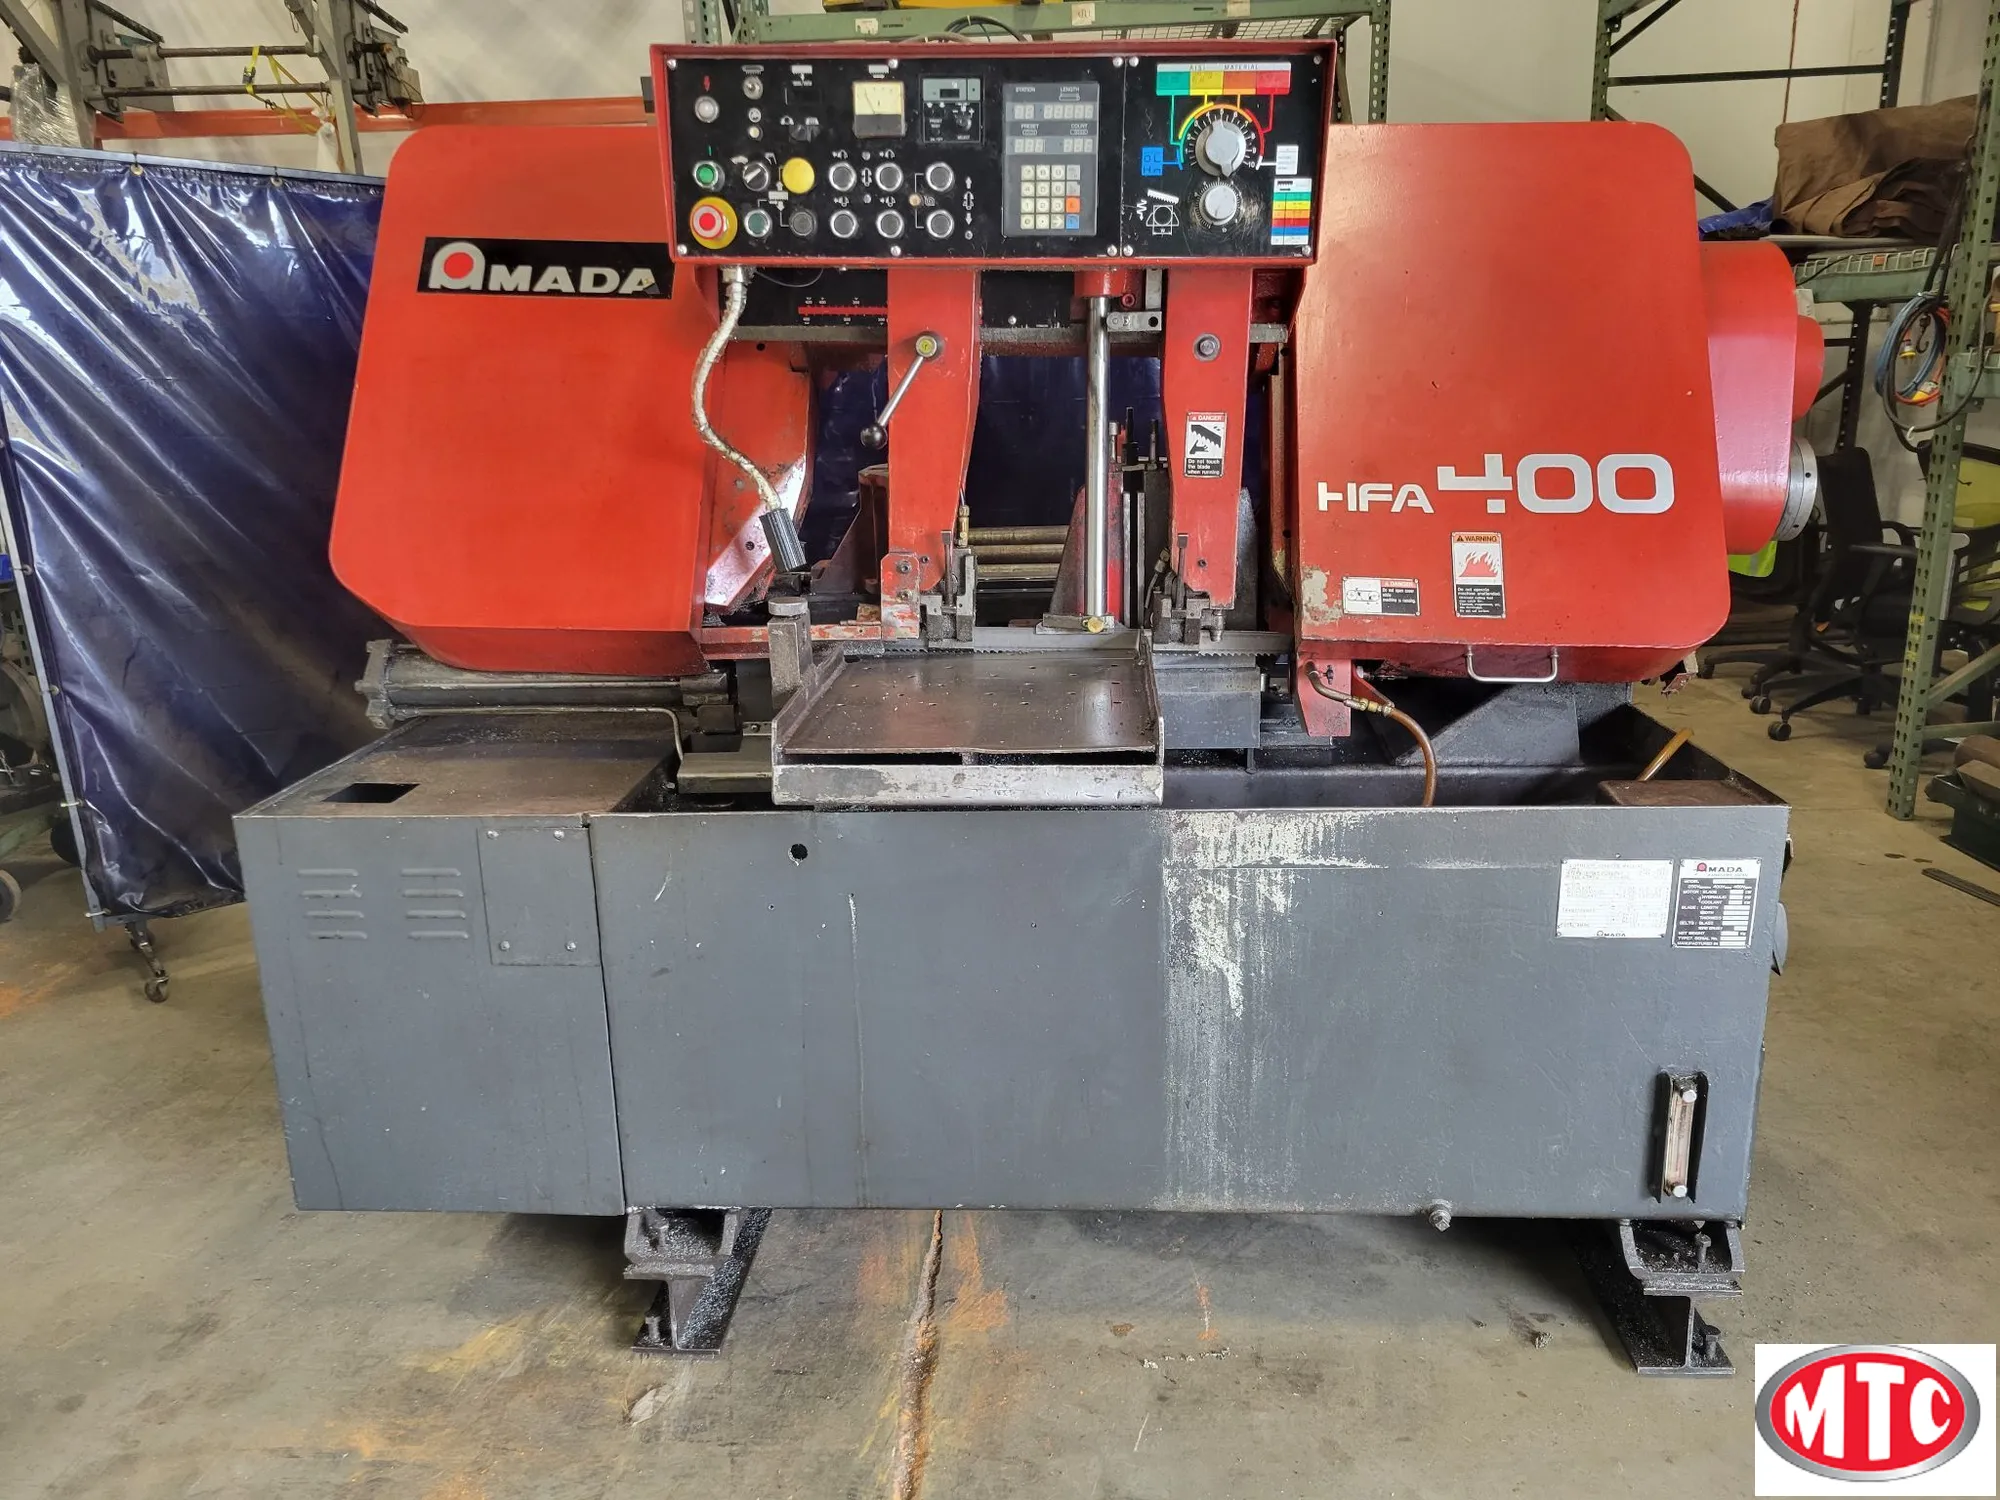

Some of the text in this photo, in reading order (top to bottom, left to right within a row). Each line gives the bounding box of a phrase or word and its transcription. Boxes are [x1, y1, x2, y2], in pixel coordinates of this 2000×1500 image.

[428, 241, 660, 294] AMADA
[1318, 453, 1675, 514] HFA 400
[1697, 862, 1743, 872] AMADA
